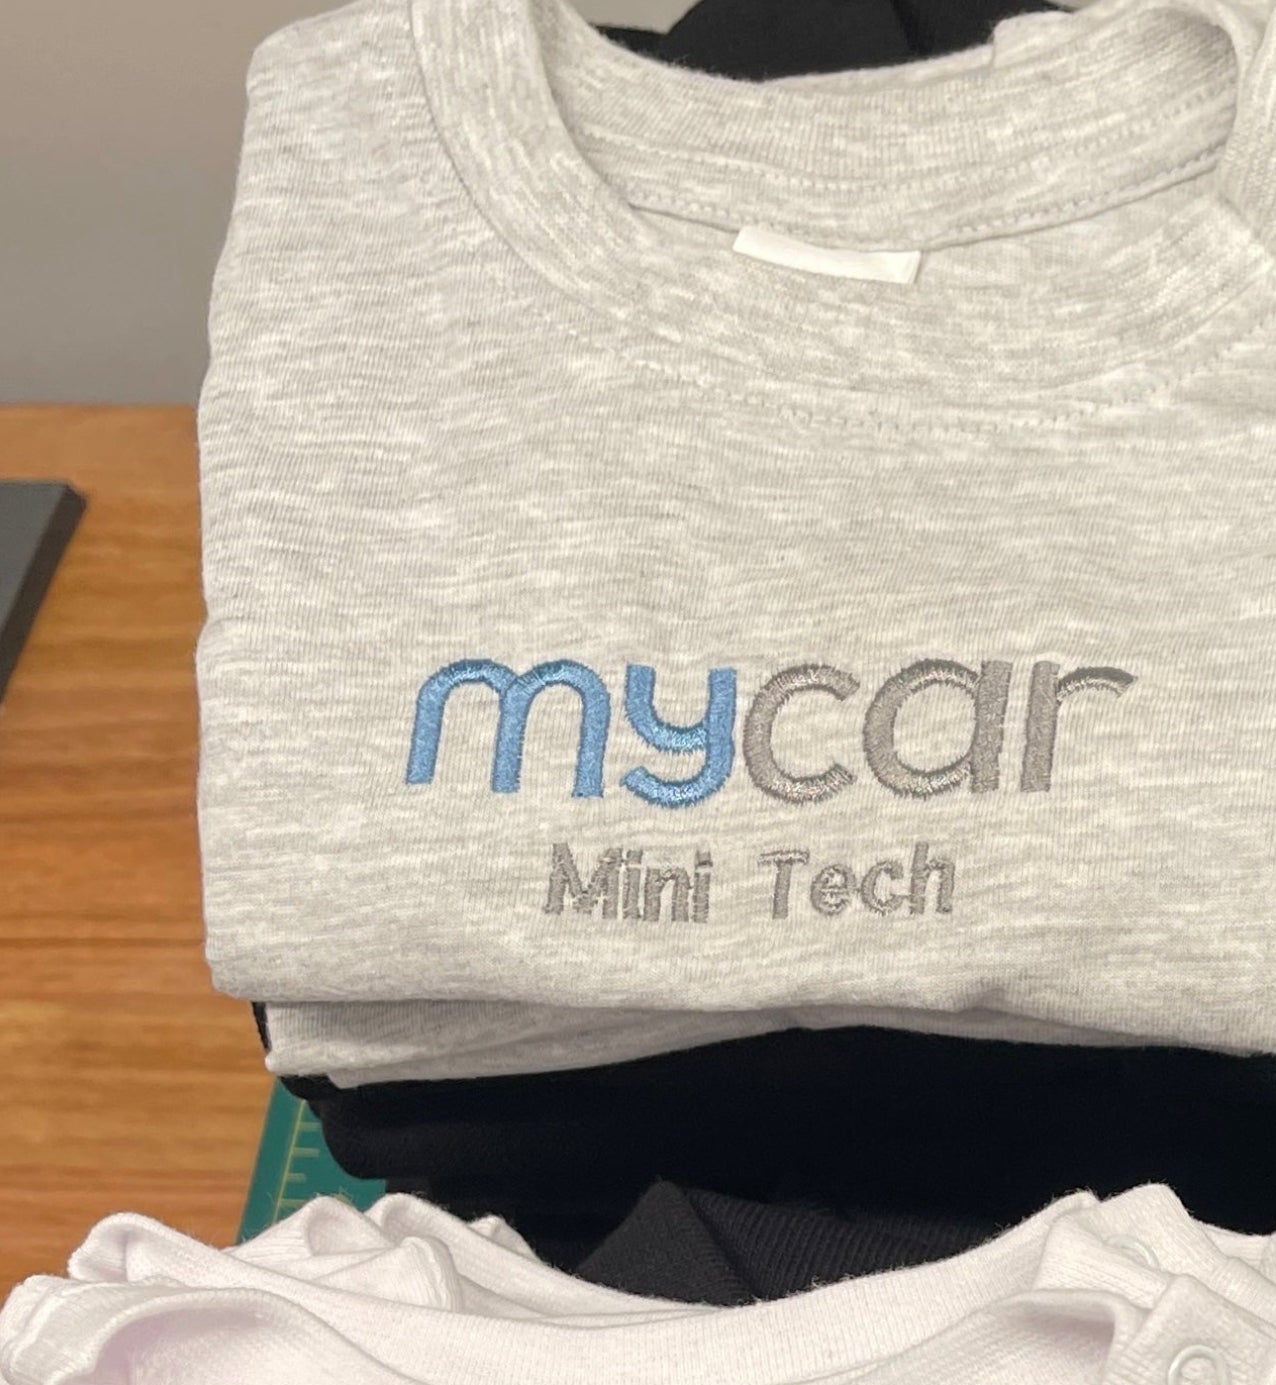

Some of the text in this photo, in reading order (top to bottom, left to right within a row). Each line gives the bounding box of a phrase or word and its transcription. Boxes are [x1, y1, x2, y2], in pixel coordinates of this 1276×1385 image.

[404, 657, 1138, 810] mycar
[541, 841, 955, 925] Mini Tech
